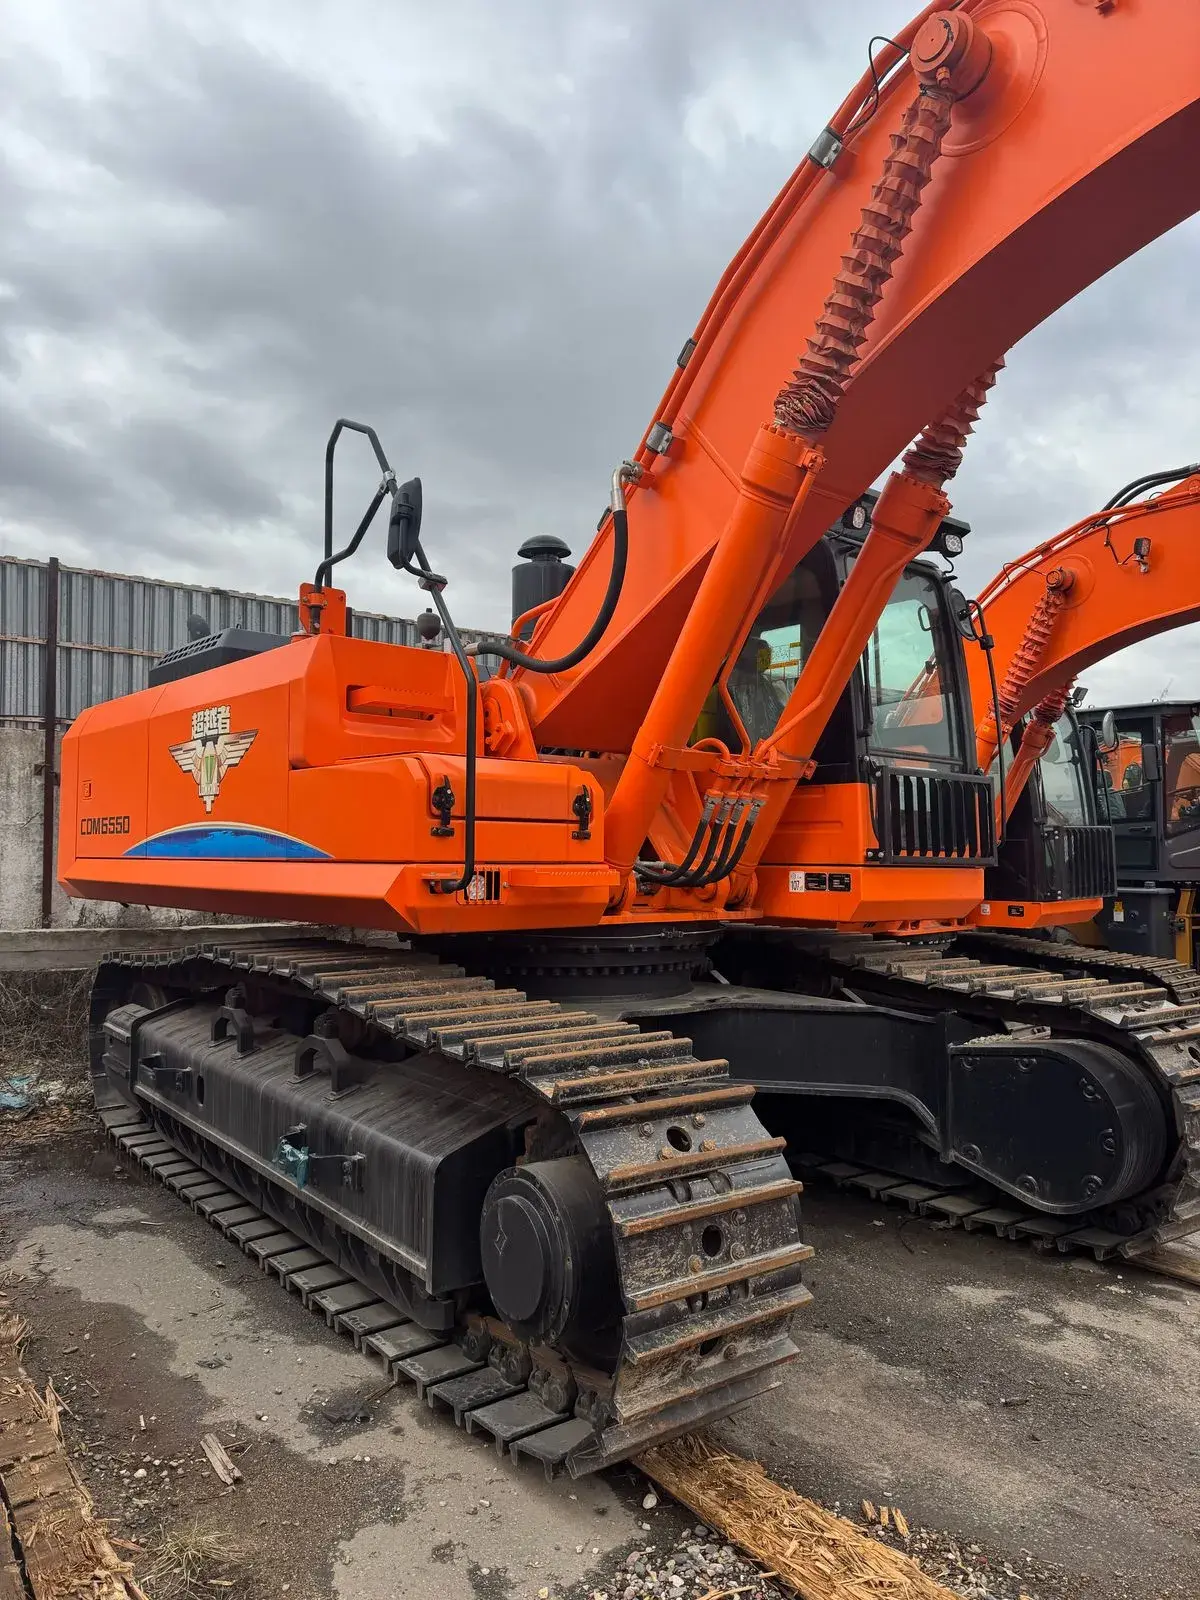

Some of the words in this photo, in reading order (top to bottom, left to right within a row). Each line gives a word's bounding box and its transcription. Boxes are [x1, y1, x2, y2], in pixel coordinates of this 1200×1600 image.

[192, 705, 230, 740] 超越者
[80, 815, 130, 836] CDM6550
